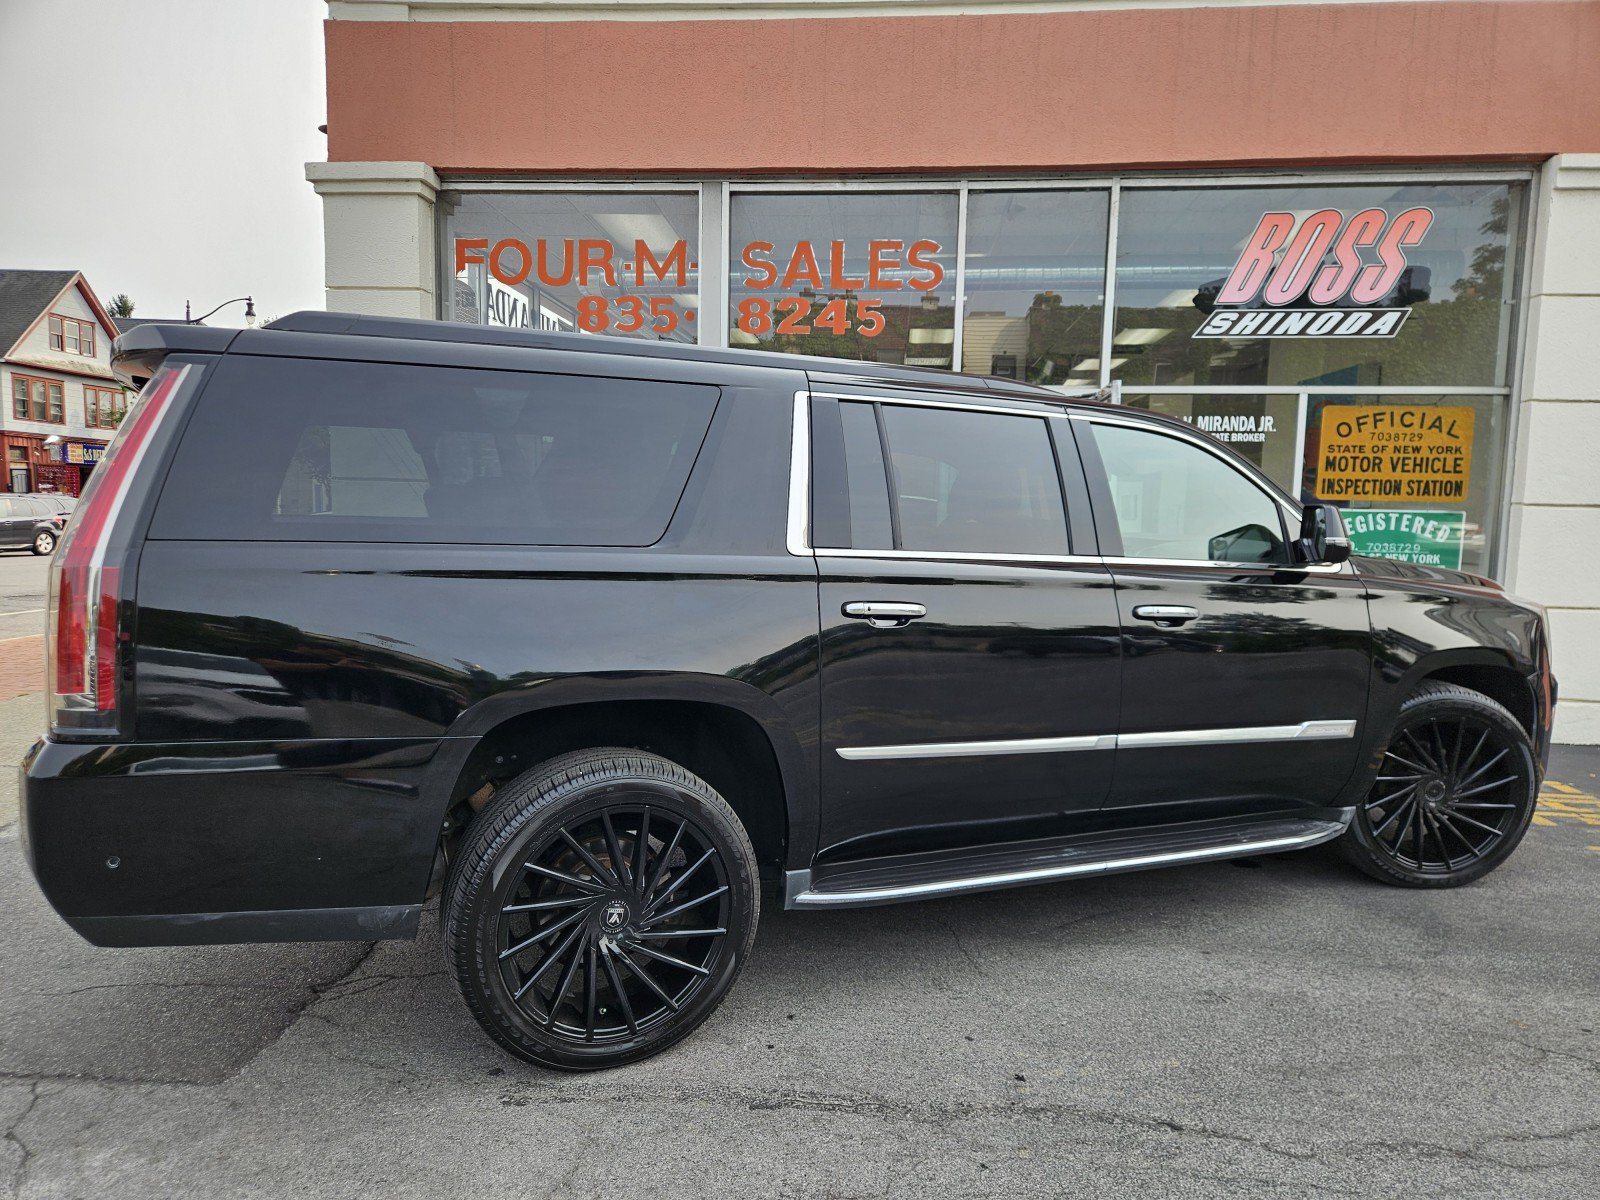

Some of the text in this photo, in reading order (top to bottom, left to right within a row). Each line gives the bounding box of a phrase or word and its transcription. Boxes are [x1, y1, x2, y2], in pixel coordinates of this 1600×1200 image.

[741, 238, 945, 292] SALES
[1214, 206, 1435, 306] BOSS
[738, 297, 886, 337] 8245
[1202, 311, 1402, 336] SHINODA
[1197, 415, 1256, 432] MIRANDA
[1257, 415, 1277, 432] JR.
[1336, 411, 1460, 439] OFFICIAL
[1231, 433, 1266, 442] BROKER
[1369, 432, 1424, 442] 7038729
[1327, 444, 1463, 455] STATE OF NEW YORK
[1324, 455, 1464, 474] MOTOR VEHICLE
[1321, 477, 1464, 497] INSPECTION STATION
[1344, 512, 1451, 543] EGISTERED
[1366, 542, 1421, 553] 7038729
[1412, 554, 1441, 565] YORK
